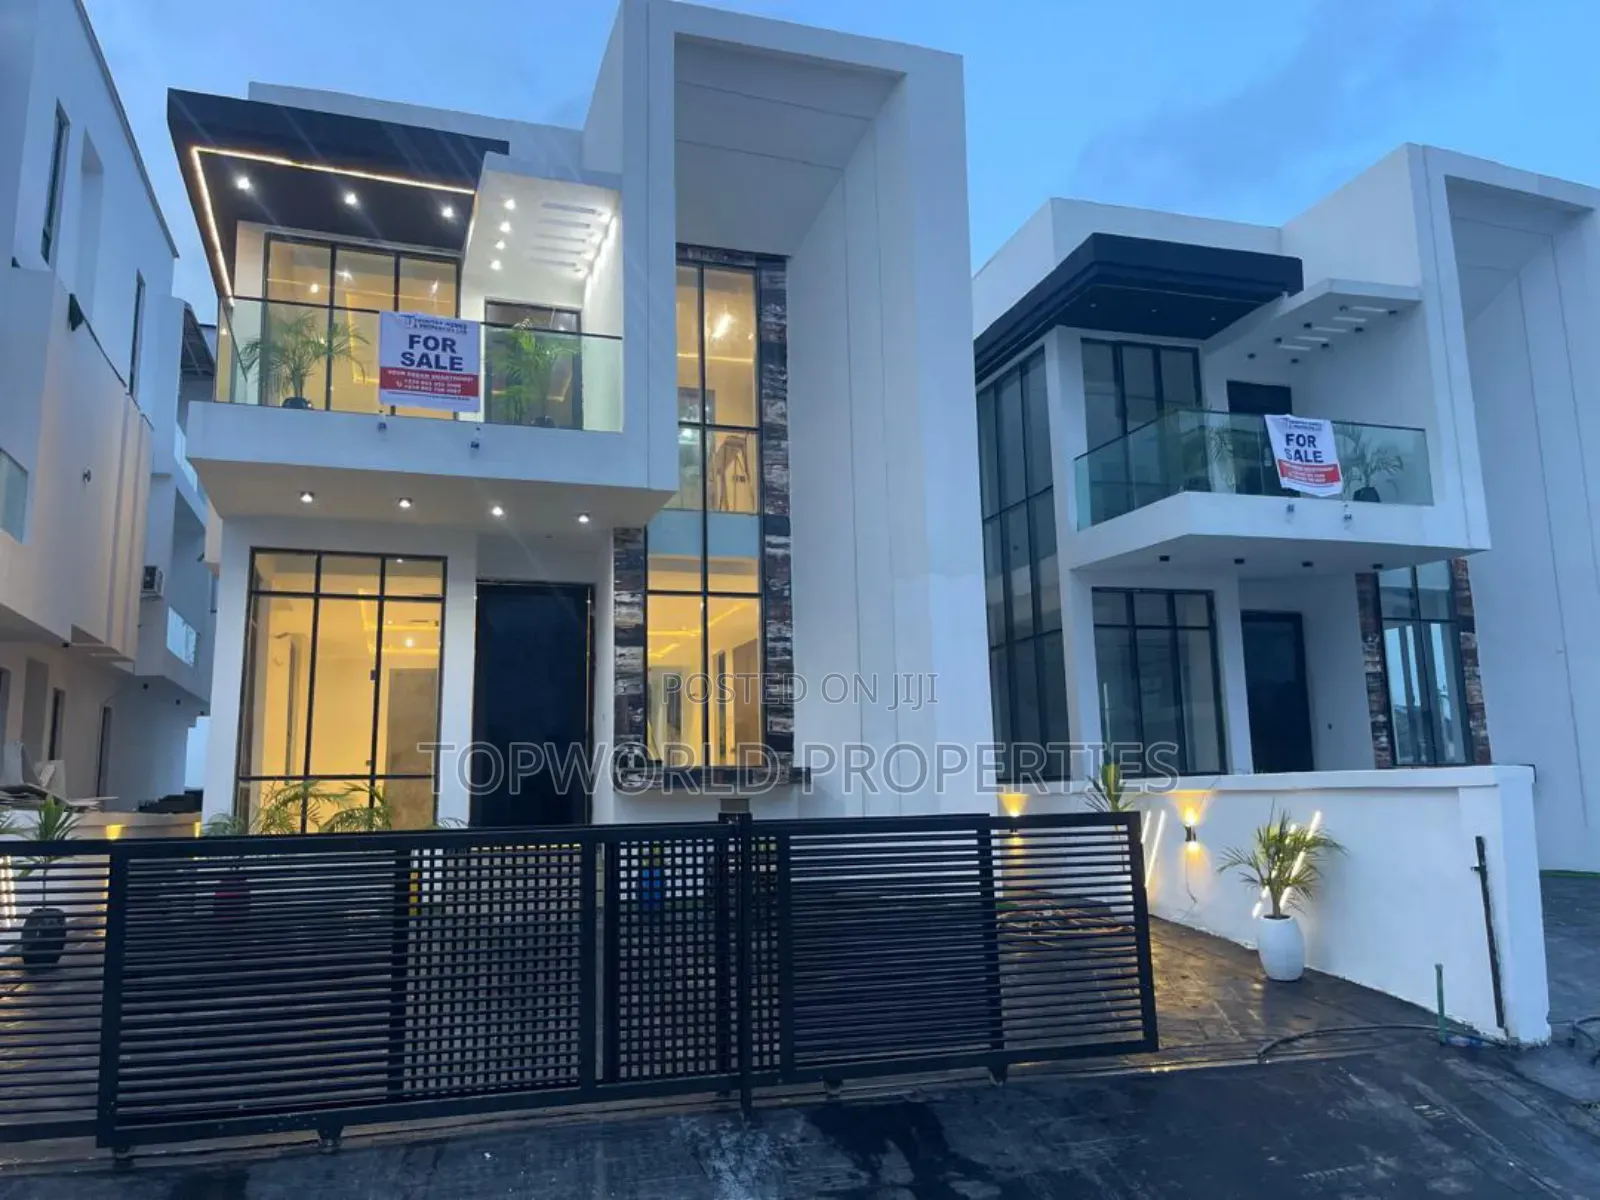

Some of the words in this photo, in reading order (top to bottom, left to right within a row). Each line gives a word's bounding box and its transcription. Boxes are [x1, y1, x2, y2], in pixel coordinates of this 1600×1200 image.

[408, 334, 457, 354] FOR
[400, 351, 463, 371] SALE
[1285, 433, 1316, 448] FOR
[1284, 448, 1324, 463] SALE
